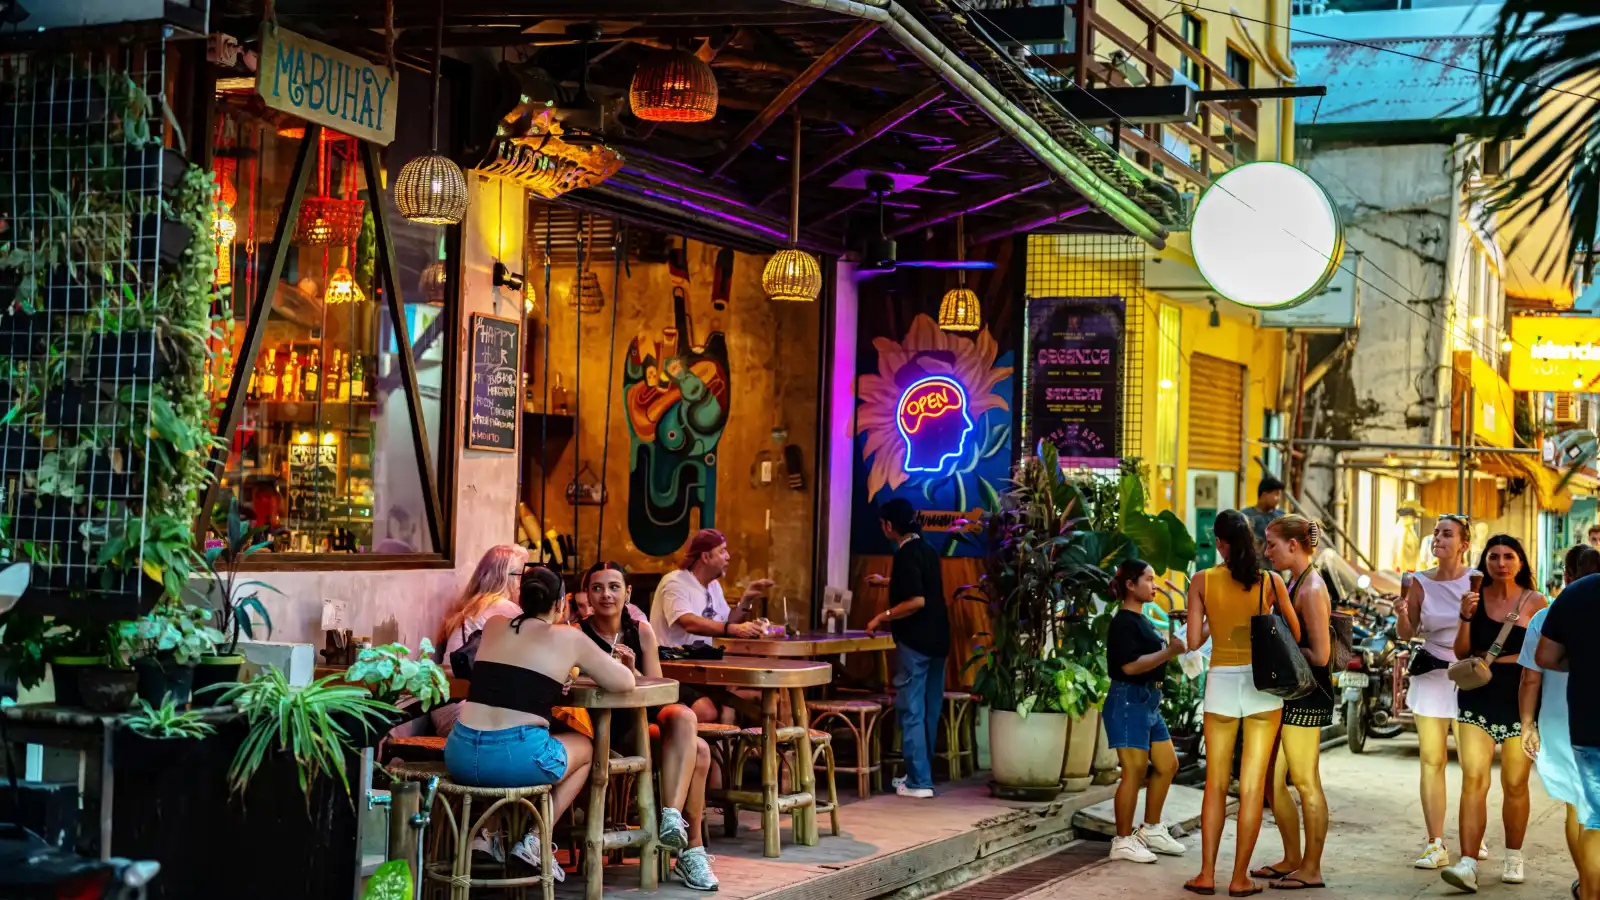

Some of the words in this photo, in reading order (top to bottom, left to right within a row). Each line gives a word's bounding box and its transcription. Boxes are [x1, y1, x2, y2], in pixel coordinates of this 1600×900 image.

[273, 41, 391, 130] MABUHAY
[480, 325, 516, 349] HAPPY
[907, 388, 949, 415] OPEN
